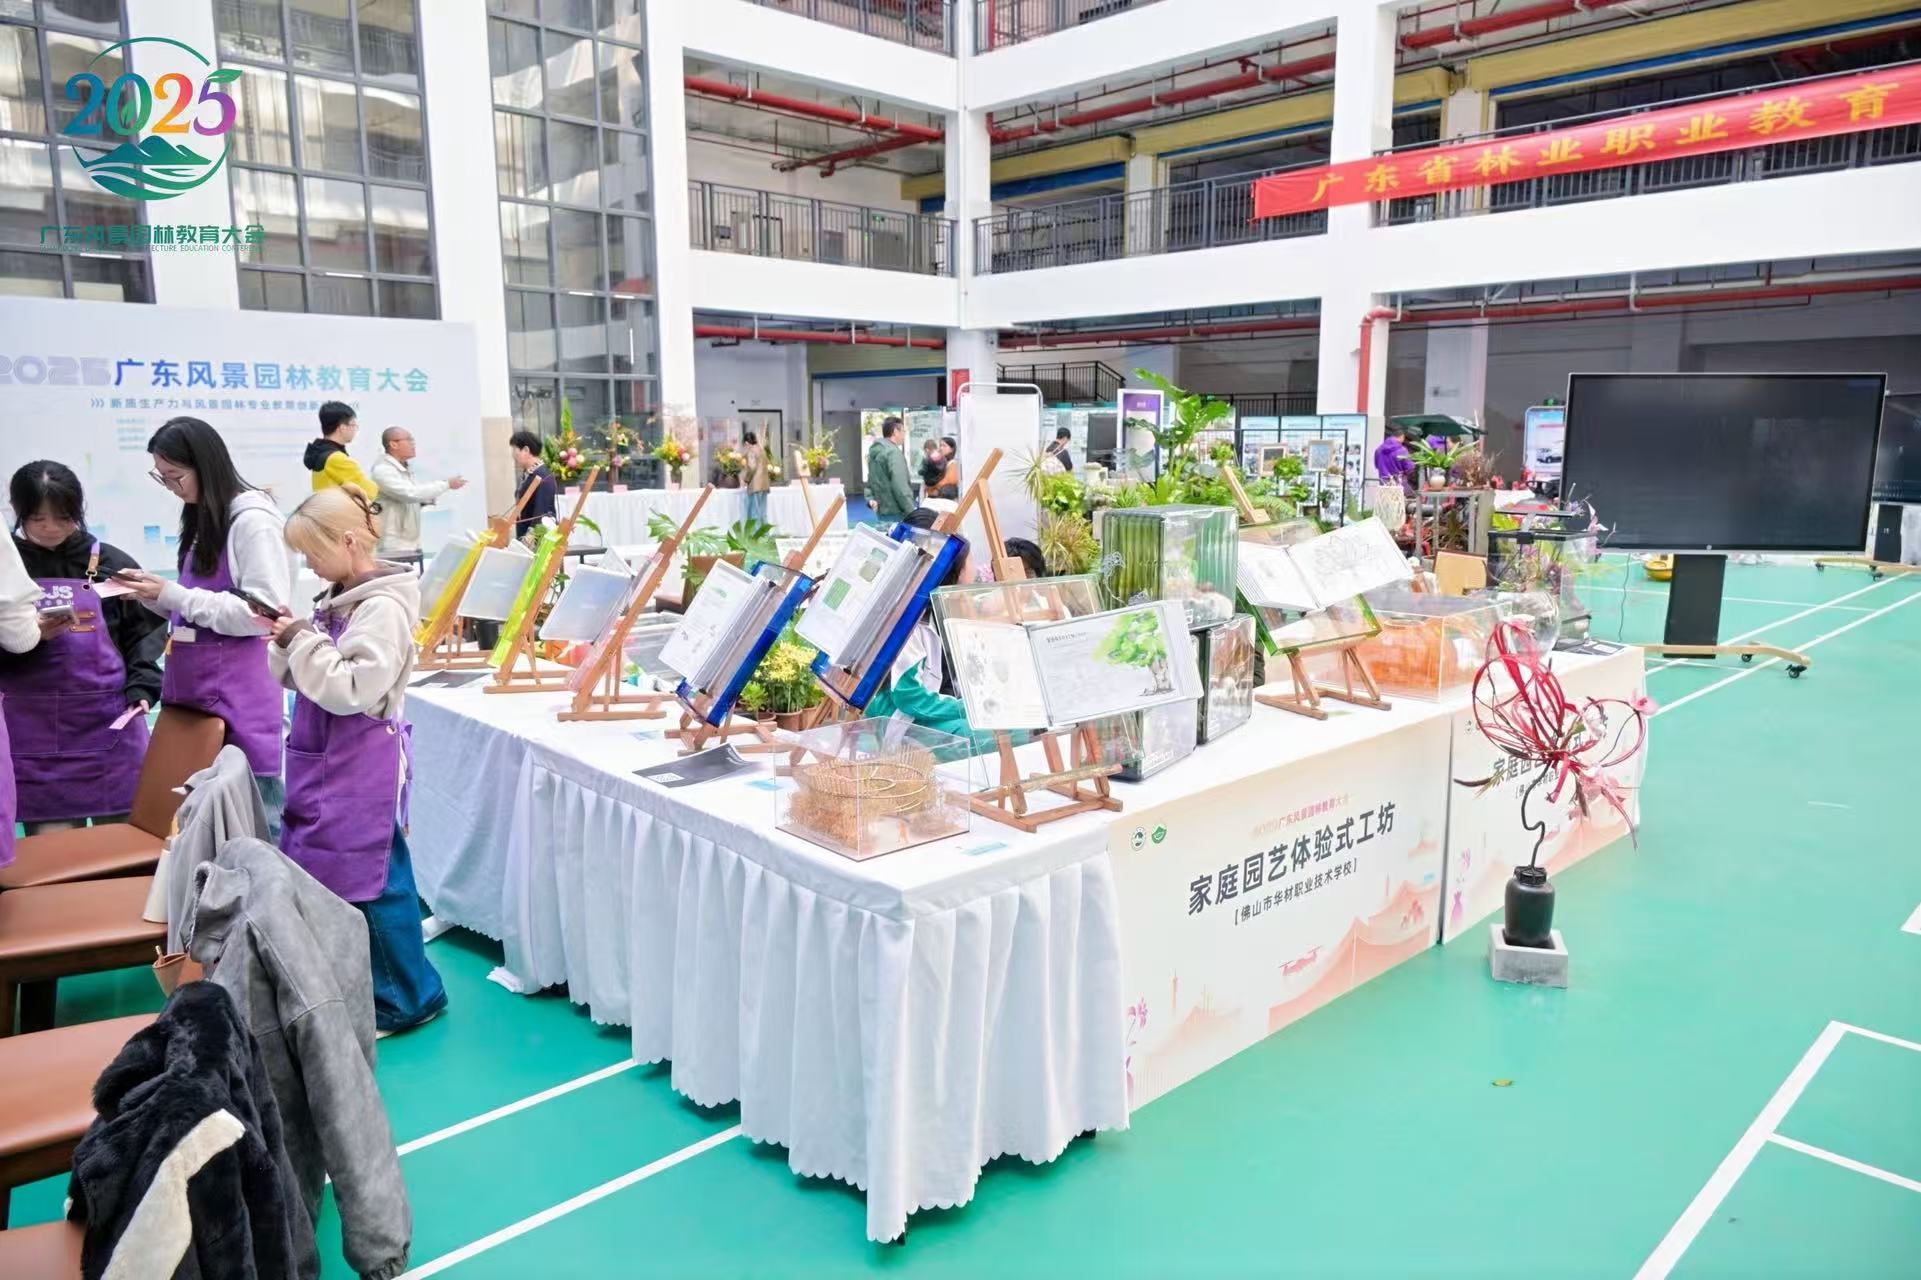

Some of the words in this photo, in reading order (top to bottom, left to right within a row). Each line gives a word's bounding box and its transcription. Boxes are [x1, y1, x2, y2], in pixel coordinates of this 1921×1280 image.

[1311, 81, 1900, 204] 广东省林业职业教育
[1188, 801, 1396, 916] 家庭园艺体验式工坊
